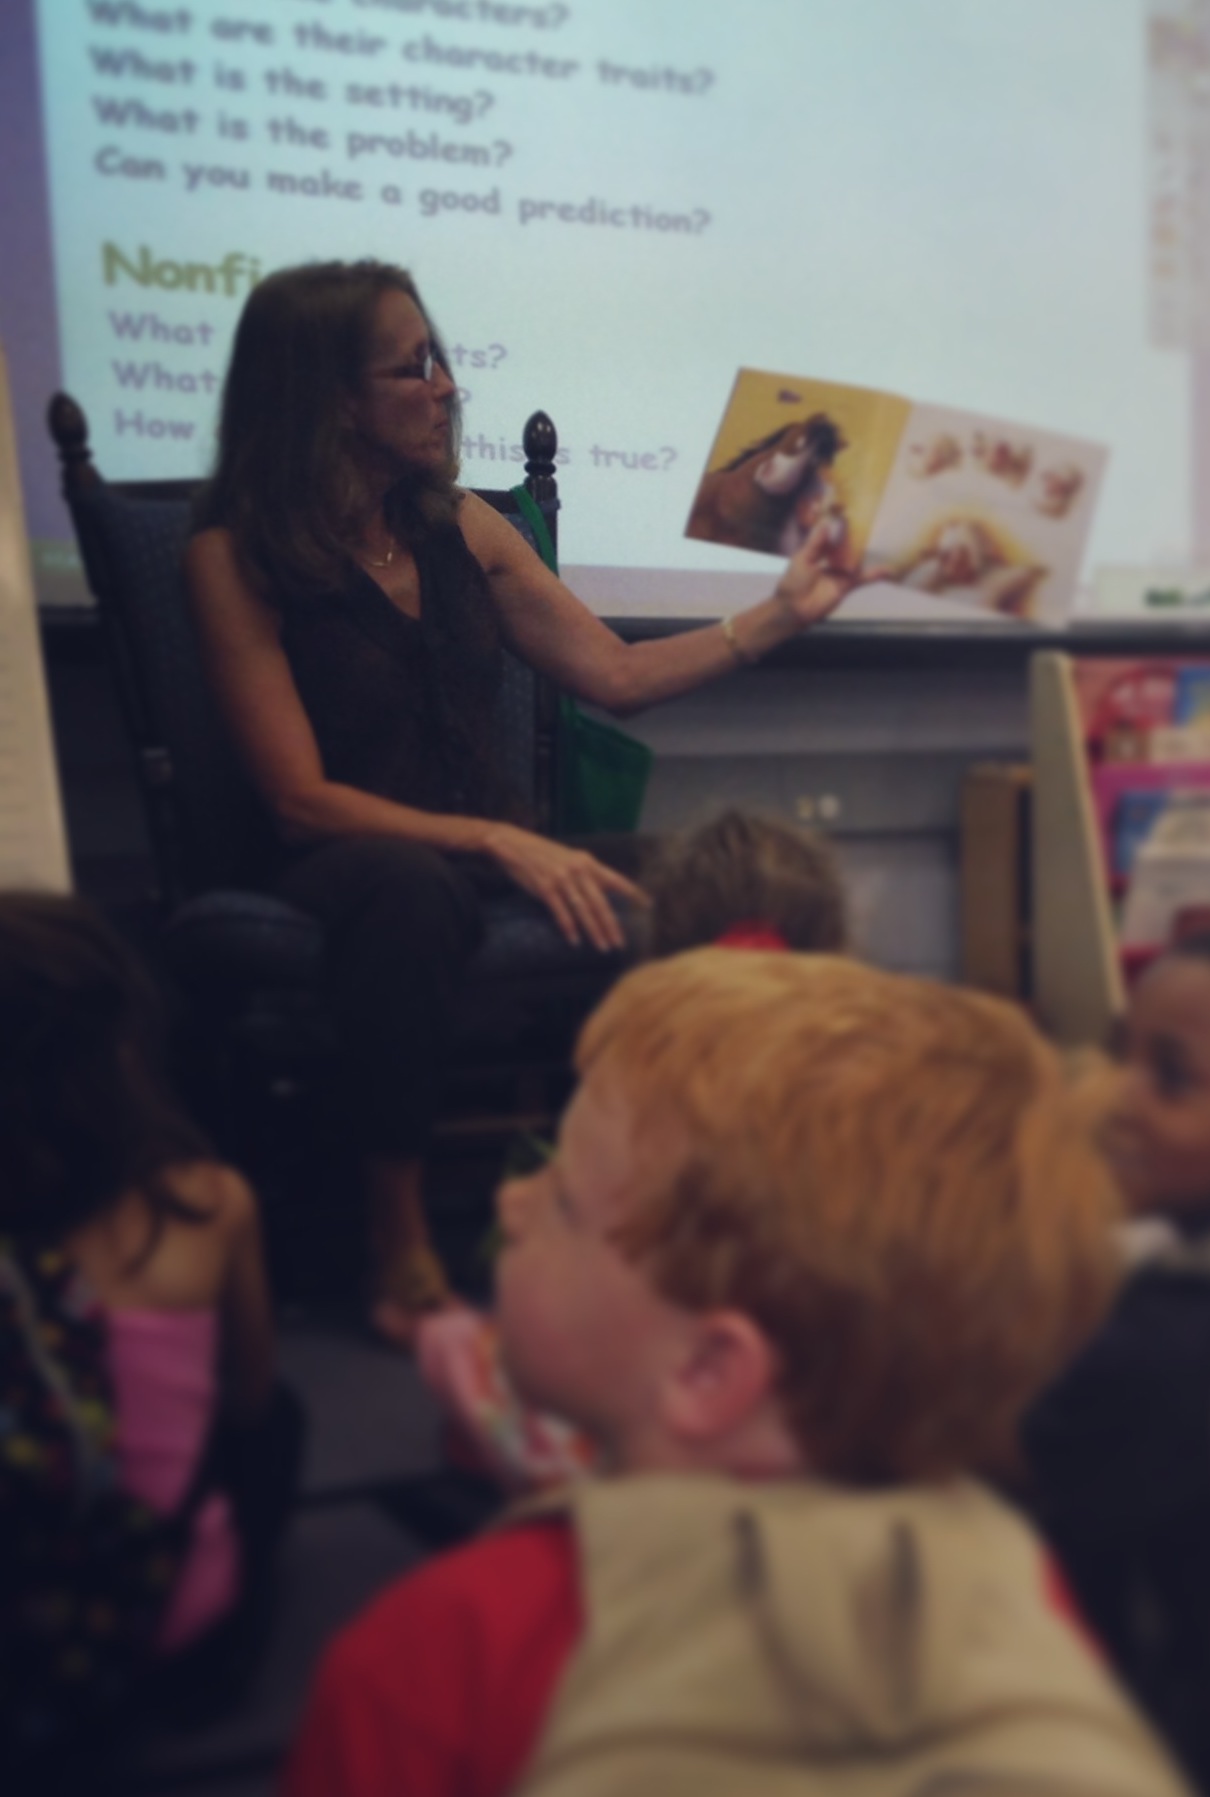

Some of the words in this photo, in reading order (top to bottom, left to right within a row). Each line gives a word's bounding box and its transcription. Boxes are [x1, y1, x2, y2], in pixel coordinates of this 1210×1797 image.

[86, 0, 192, 34] What
[210, 18, 274, 46] are
[293, 21, 387, 56] their
[402, 33, 580, 80] character
[597, 58, 716, 96] traits?
[88, 44, 196, 84] What
[213, 58, 246, 92] is
[264, 66, 327, 100] the
[346, 82, 495, 125] setting?
[91, 95, 199, 134] What
[217, 109, 249, 141] is
[267, 116, 330, 150] the
[347, 129, 513, 168] problem?
[95, 146, 166, 181] Can
[184, 162, 250, 192] you
[267, 169, 363, 201] make
[381, 184, 402, 206] a
[418, 186, 501, 217] good
[518, 196, 712, 236] prediction?
[102, 241, 263, 297] Nonfi
[108, 310, 214, 347] What
[112, 359, 218, 395] What
[114, 409, 196, 440] How
[462, 433, 525, 462] this
[591, 445, 678, 472] true?
